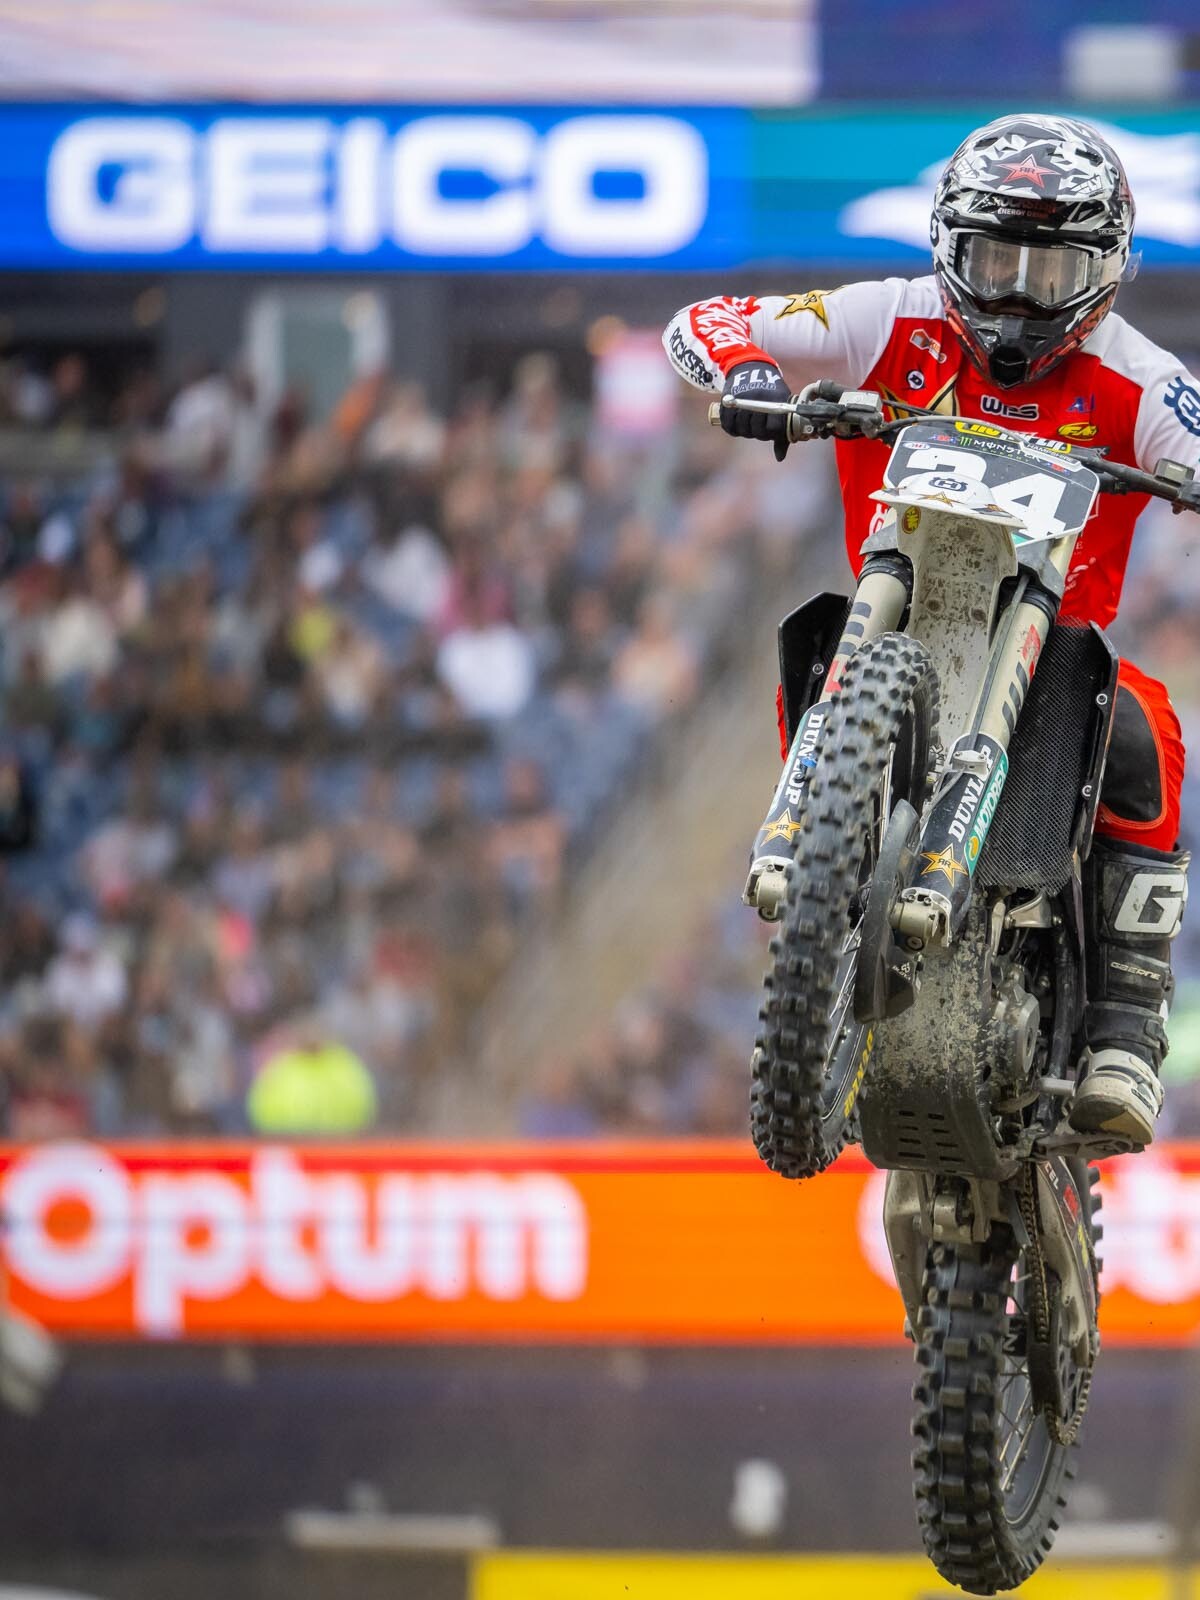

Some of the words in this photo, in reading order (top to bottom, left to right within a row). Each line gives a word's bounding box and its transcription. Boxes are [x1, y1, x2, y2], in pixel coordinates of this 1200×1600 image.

[47, 115, 708, 257] GEICO
[998, 207, 1026, 216] ENERGY
[733, 369, 781, 386] FLY
[973, 439, 1042, 462] MONSTER
[948, 745, 992, 842] DUNLP
[973, 760, 1008, 840] MOTOREX
[1114, 873, 1185, 933] G
[2, 1140, 589, 1338] Optum
